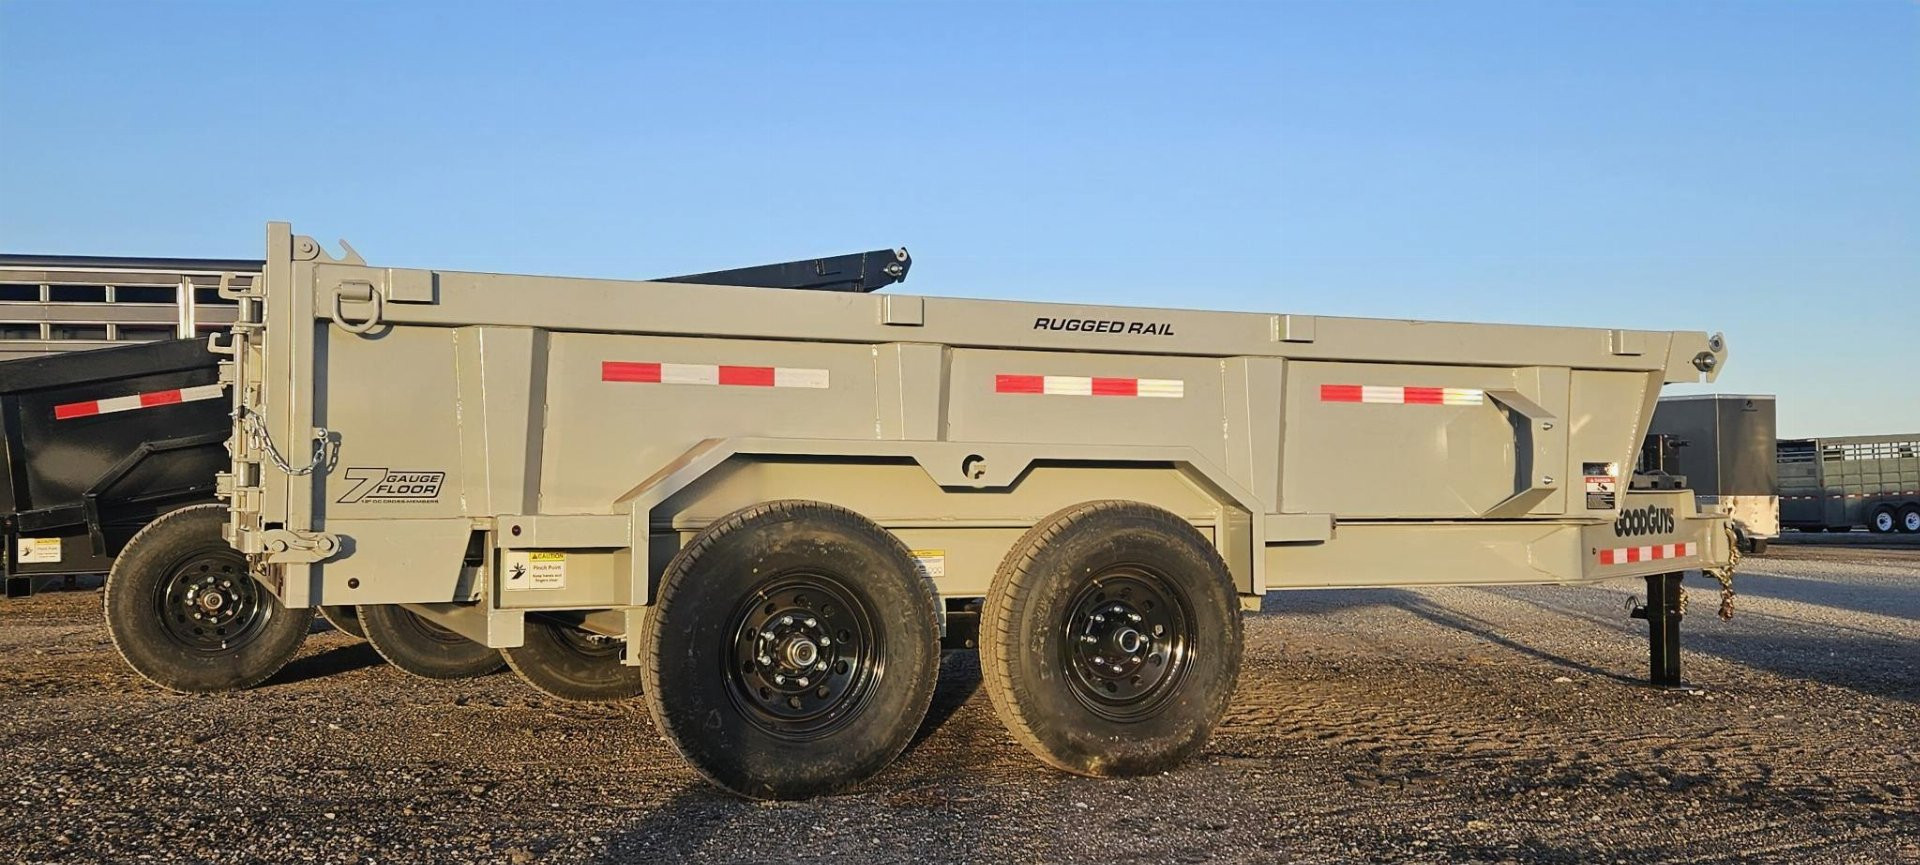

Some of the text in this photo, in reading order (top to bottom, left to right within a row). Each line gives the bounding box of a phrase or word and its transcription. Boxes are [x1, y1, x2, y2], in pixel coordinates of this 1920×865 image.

[1033, 317, 1175, 336] RUGGED RAIL
[335, 467, 389, 504] 7
[386, 475, 441, 483] GAUGE
[375, 485, 437, 494] FLOOR
[1614, 504, 1675, 538] GOODGUYS
[537, 552, 564, 560] CAUTION
